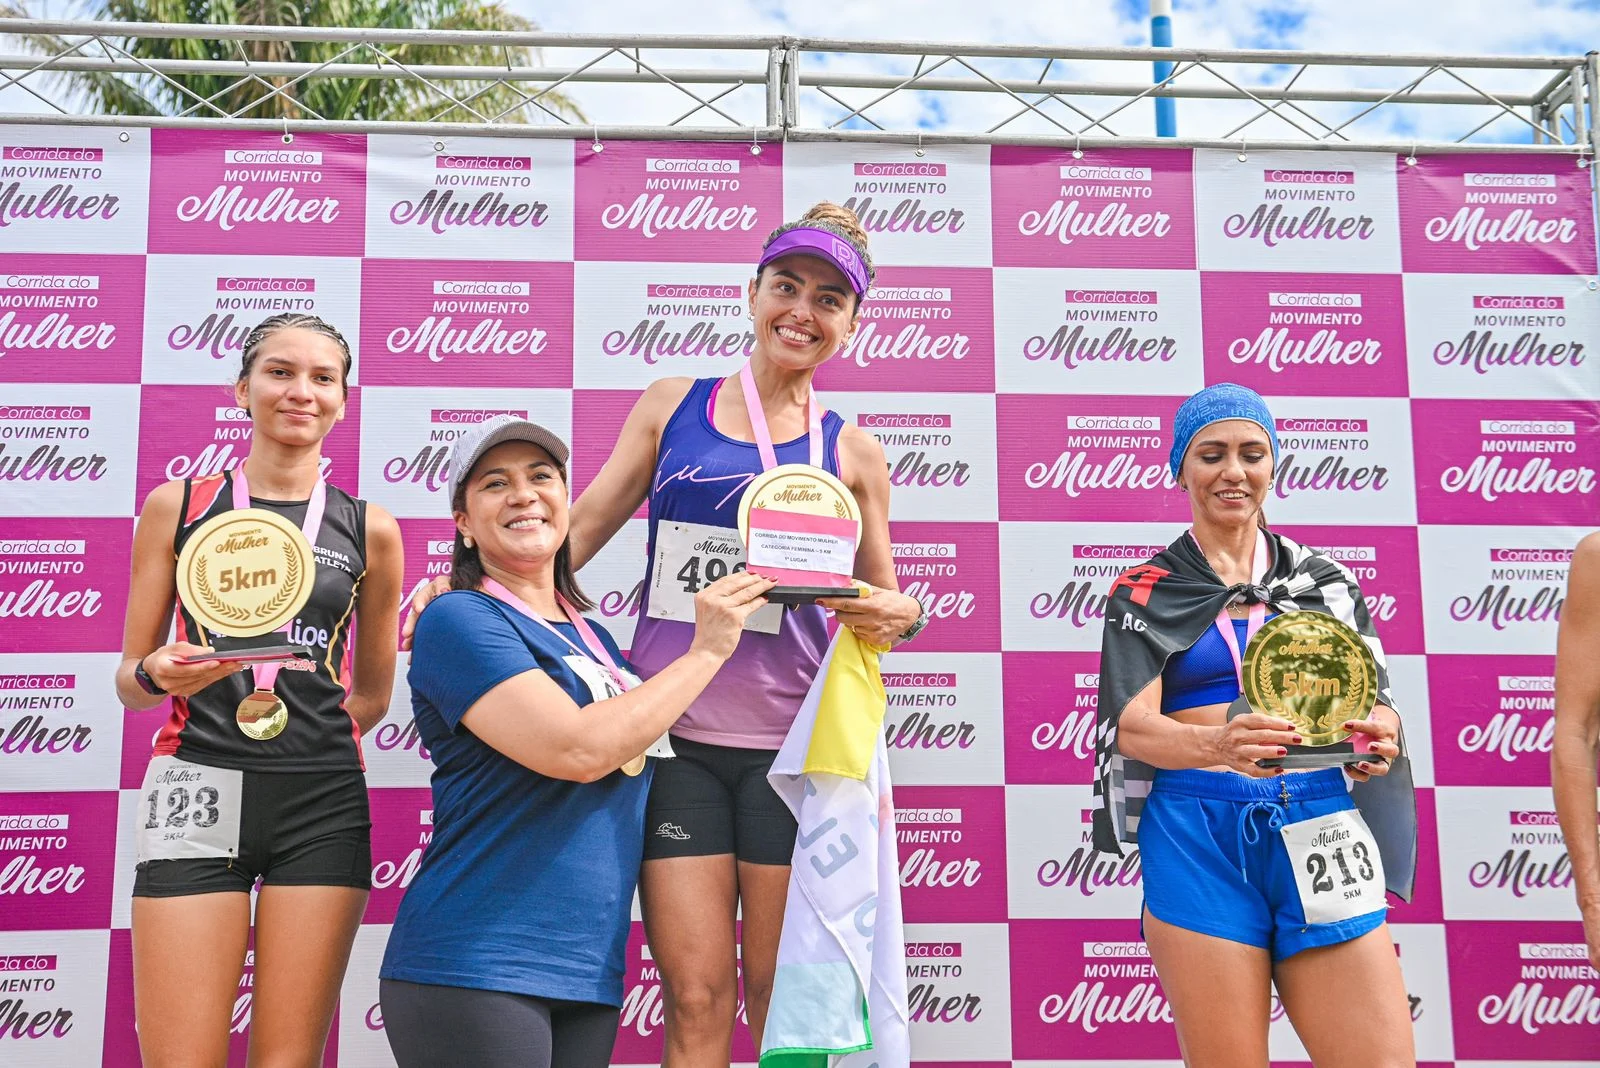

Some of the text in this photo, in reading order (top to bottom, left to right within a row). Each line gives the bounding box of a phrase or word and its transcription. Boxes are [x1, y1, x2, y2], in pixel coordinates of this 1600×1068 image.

[12, 147, 94, 160] Corrida do
[234, 150, 314, 163] Corrida do
[445, 156, 523, 168] Corrida do
[655, 159, 732, 171] Corrida do
[862, 162, 938, 175] Corrida do
[2, 166, 101, 180] MOVIMENTO
[224, 169, 321, 183] MOVIMENTO
[1068, 166, 1144, 179] Corrida do
[1272, 170, 1347, 182] Corrida do
[1473, 173, 1548, 185] Corrida do
[435, 174, 531, 188] MOVIMENTO
[645, 178, 740, 191] MOVIMENTO
[853, 181, 947, 194] MOVIMENTO
[1060, 185, 1152, 198] MOVIMENTO
[1264, 189, 1355, 201] MOVIMENTO
[1465, 192, 1556, 204] MOVIMENTO
[177, 185, 339, 230] Mulher
[390, 190, 549, 234] Mulher
[601, 193, 758, 237] Mulher
[1018, 200, 1171, 243] Mulher
[1222, 204, 1375, 247] Mulher
[1425, 207, 1576, 250] Mulher
[7, 275, 89, 288] Corrida do
[226, 277, 306, 290] Corrida do
[442, 280, 521, 293] Corrida do
[656, 284, 734, 297] Corrida do
[866, 287, 943, 300] Corrida do
[1074, 290, 1150, 302] Corrida do
[0, 295, 98, 308] MOVIMENTO
[216, 297, 314, 310] MOVIMENTO
[1278, 293, 1353, 305] Corrida do
[1482, 296, 1557, 308] Corrida do
[432, 300, 529, 313] MOVIMENTO
[646, 303, 742, 316] MOVIMENTO
[857, 306, 951, 320] MOVIMENTO
[1065, 309, 1158, 322] MOVIMENTO
[1270, 312, 1362, 325] MOVIMENTO
[1474, 315, 1566, 327] MOVIMENTO
[387, 316, 548, 361] Mulher
[602, 319, 755, 364] Mulher
[1023, 324, 1178, 369] Mulher
[1228, 327, 1382, 372] Mulher
[1433, 330, 1586, 374] Mulher
[60, 406, 82, 419] do
[865, 413, 943, 426] Corrida do
[1075, 416, 1152, 428] Corrida do
[1283, 418, 1336, 430] Corrida
[1340, 418, 1360, 431] do
[0, 426, 89, 439] OVIMENTO
[1490, 420, 1566, 433] Corrida do
[873, 433, 952, 446] OVIMENTO
[1067, 435, 1161, 448] MOVIMENTO
[1276, 438, 1369, 450] MOVIMENTO
[1482, 440, 1575, 452] MOVIMENTO
[0, 444, 107, 482] ulher
[1024, 451, 1177, 496] Mulher
[1441, 455, 1596, 500] Mulher
[774, 490, 822, 504] Mulher
[229, 528, 262, 538] MOVIMENTO
[55, 539, 77, 552] do
[216, 536, 270, 554] Mulher
[694, 540, 740, 556] Mulher
[927, 543, 948, 556] do
[1081, 544, 1135, 557] Corrida
[314, 546, 350, 564] BRUNA
[1348, 547, 1368, 559] do
[1499, 548, 1574, 561] Corrida do
[0, 561, 84, 574] OVIMENTO
[894, 563, 956, 576] IMENTO
[218, 566, 276, 593] 5km
[1491, 568, 1567, 581] MOVIMEN
[0, 579, 102, 617] ulher
[45, 673, 66, 687] do
[881, 673, 948, 686] orrida do
[1282, 672, 1340, 697] 5km
[0, 695, 74, 709] VIMENTO
[886, 694, 956, 706] VIMENTO
[156, 770, 202, 786] Mulher
[145, 786, 219, 830] 123
[932, 808, 953, 821] do
[38, 813, 60, 827] do
[1312, 829, 1350, 848] Mulher
[1306, 841, 1374, 894] 213
[1344, 888, 1362, 900] 5KM
[932, 942, 953, 955] do
[26, 953, 48, 967] do
[1083, 963, 1158, 976] MOVIMEN
[1520, 964, 1600, 978] MOVIMEN
[1038, 983, 1174, 1032] Mulhe
[1477, 984, 1600, 1033] Mulh
